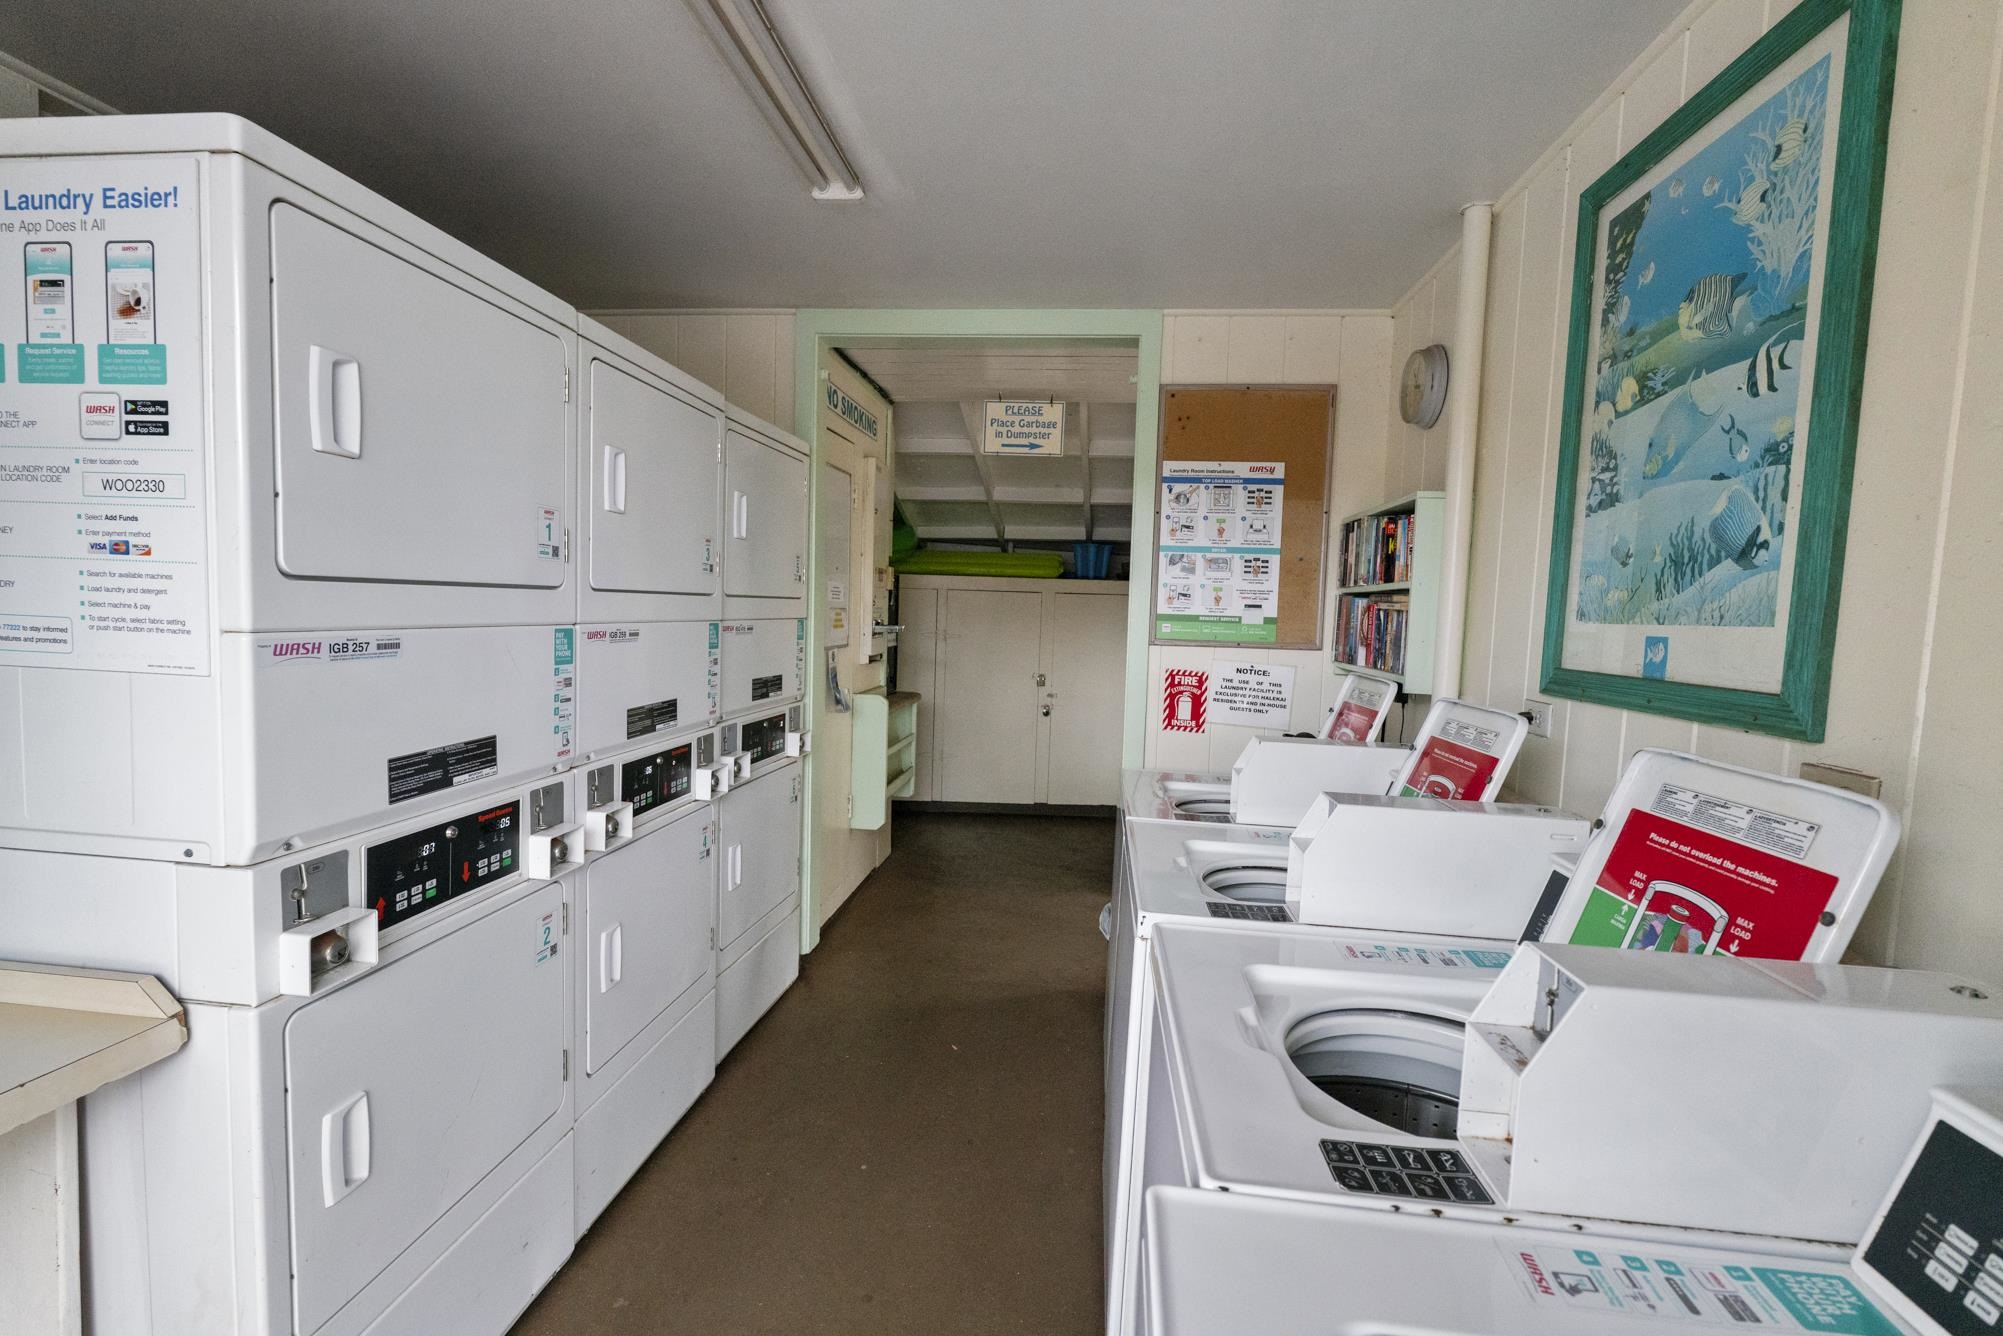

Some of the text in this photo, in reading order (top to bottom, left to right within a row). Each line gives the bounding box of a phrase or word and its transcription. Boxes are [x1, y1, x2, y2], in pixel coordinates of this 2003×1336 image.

[4, 186, 178, 215] Laundry Easier!
[19, 220, 41, 235] App
[46, 219, 76, 232] Does
[80, 218, 88, 231] It
[91, 218, 106, 231] All
[86, 405, 115, 414] WASH
[155, 406, 166, 414] Play
[827, 384, 877, 437] NO SMOKING
[1005, 405, 1044, 415] PLEASE
[5, 411, 20, 419] THE
[22, 420, 37, 428] APP
[990, 418, 1058, 429] Place Garbage
[994, 428, 1052, 439] in Dumpster
[9, 464, 43, 473] LAUNDRY
[1, 473, 38, 482] LOCATION
[84, 513, 103, 521] Select
[545, 523, 551, 541] 1
[89, 542, 107, 550] VISA
[103, 586, 125, 594] laundry
[140, 588, 168, 596] detergent
[96, 624, 111, 632] push
[166, 619, 186, 627] setting
[29, 625, 41, 633] stay
[587, 631, 607, 639] WASH
[272, 641, 322, 656] WASH
[329, 642, 370, 654] IGB 257
[1236, 668, 1271, 677] NOTICE:
[1175, 675, 1199, 686] FIRE
[1171, 686, 1201, 695] EXTINGUISHER
[1215, 691, 1247, 699] EXCLUSIVE
[1249, 687, 1275, 695] FACILITY
[1213, 697, 1245, 705] RESIDENTS
[1649, 832, 1779, 887] Please do not overload the machines.
[1634, 870, 1647, 881] MAX
[1629, 878, 1645, 889] LOAD
[1736, 916, 1755, 931] MAX
[543, 926, 551, 947] 2
[1730, 926, 1751, 941] LOAD
[1520, 1252, 1556, 1296] WASH
